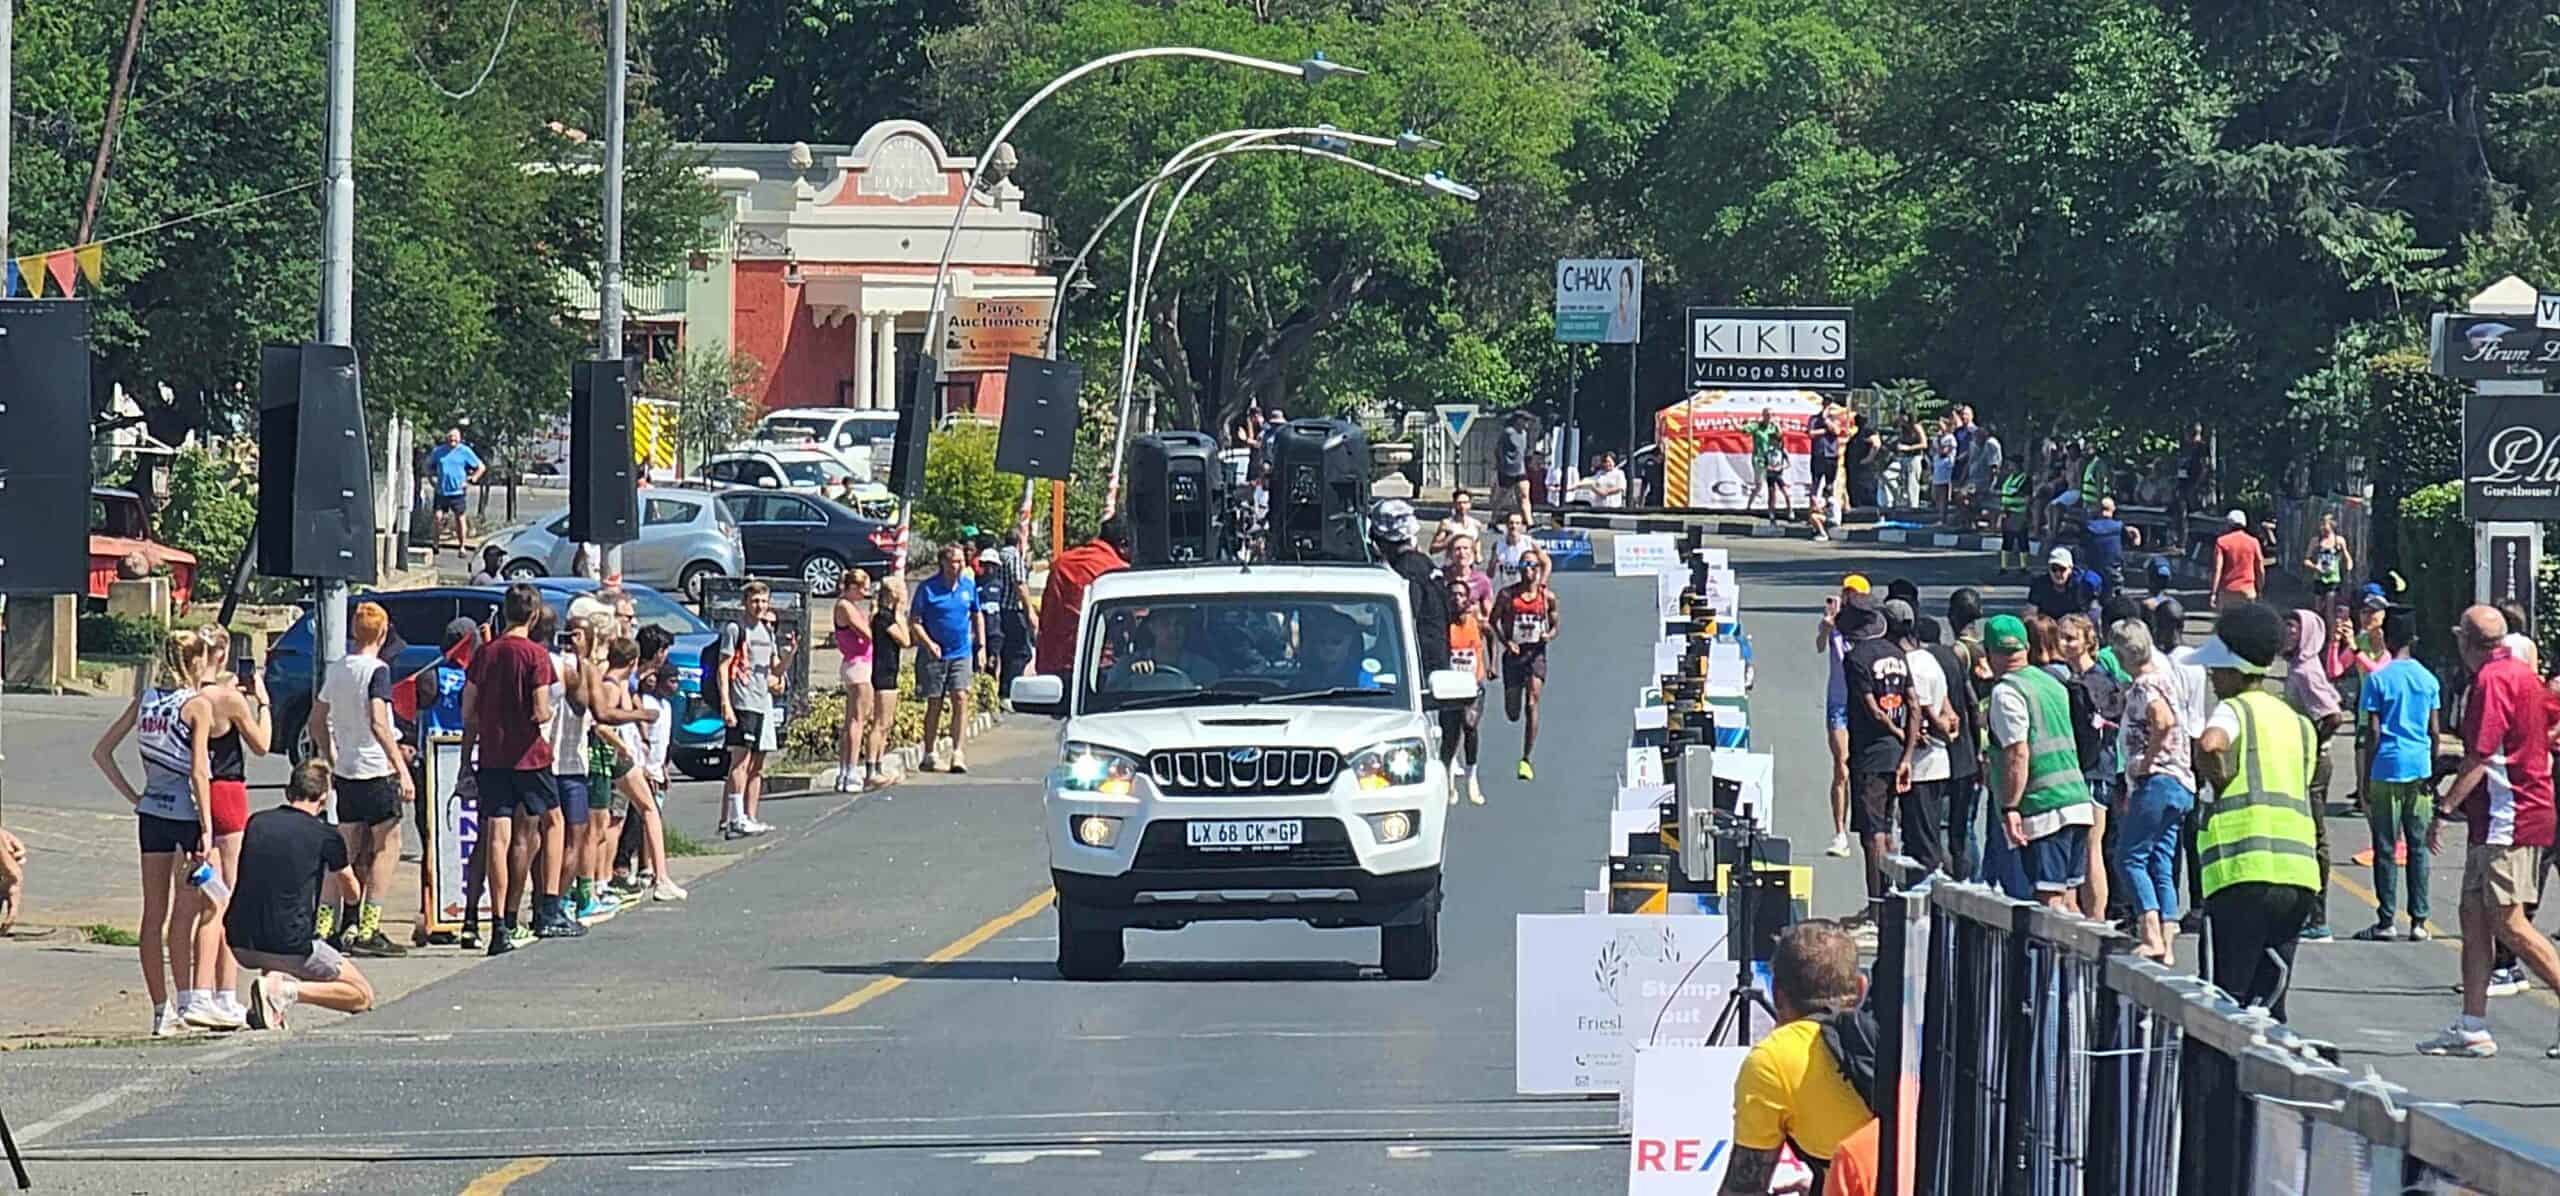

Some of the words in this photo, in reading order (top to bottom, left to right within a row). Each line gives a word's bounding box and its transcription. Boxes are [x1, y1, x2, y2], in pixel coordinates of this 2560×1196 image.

[976, 302, 1024, 316] Parys
[1703, 324, 1840, 354] KIKI'S
[1695, 363, 1774, 381] Vintage
[1780, 363, 1845, 378] Studio
[1192, 824, 1211, 843] LX
[1219, 823, 1238, 842] 68
[1246, 823, 1265, 842] CK
[1280, 823, 1298, 841] GP
